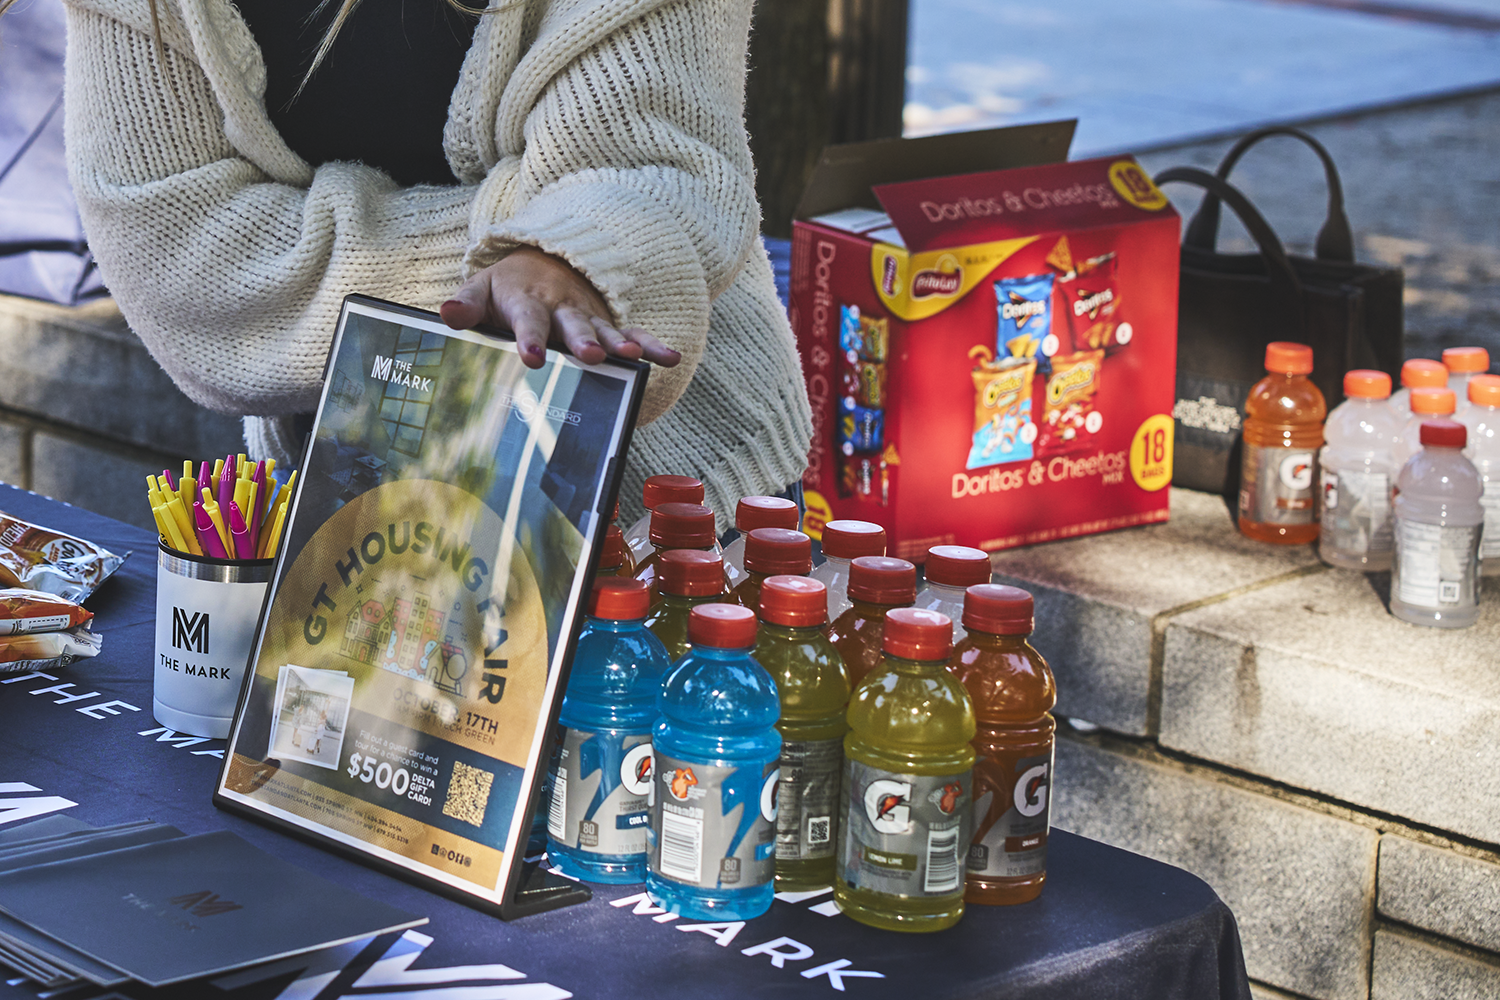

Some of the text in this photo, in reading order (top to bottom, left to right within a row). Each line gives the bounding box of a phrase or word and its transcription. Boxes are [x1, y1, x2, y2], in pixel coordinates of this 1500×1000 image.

[919, 197, 1004, 224] Doritos
[1002, 190, 1026, 213] &
[1022, 180, 1114, 210] Cheetos
[811, 240, 836, 338] Doritos
[395, 360, 413, 374] THE
[810, 344, 831, 368] &
[390, 372, 432, 392] MARK
[1142, 428, 1166, 466] 18
[952, 448, 1127, 499] Doritos & Cheetos
[1102, 471, 1126, 486] MIX
[1280, 454, 1312, 490] G
[304, 520, 509, 704] GT HOUSING FAIR
[160, 654, 231, 680] THE MARK
[0, 670, 142, 720] THE
[466, 712, 499, 735] 17TH
[360, 730, 371, 740] Fill
[370, 736, 382, 745] out
[388, 742, 408, 754] guest
[408, 749, 424, 760] card
[424, 755, 439, 765] and
[464, 728, 496, 746] GREEN
[354, 740, 369, 750] tour
[369, 744, 380, 754] for
[386, 752, 410, 766] chance
[410, 760, 419, 769] to
[420, 764, 432, 774] win
[346, 752, 410, 796] $500
[412, 773, 435, 790] DELTA
[407, 791, 432, 806] CARD!
[410, 782, 428, 794] GIFT
[1014, 762, 1048, 818] G
[864, 780, 913, 834] G
[583, 822, 595, 834] 80
[628, 816, 642, 826] COOL
[888, 858, 903, 866] LIME
[971, 846, 984, 858] 80
[724, 860, 738, 871] 80
[608, 892, 886, 992] MARK
